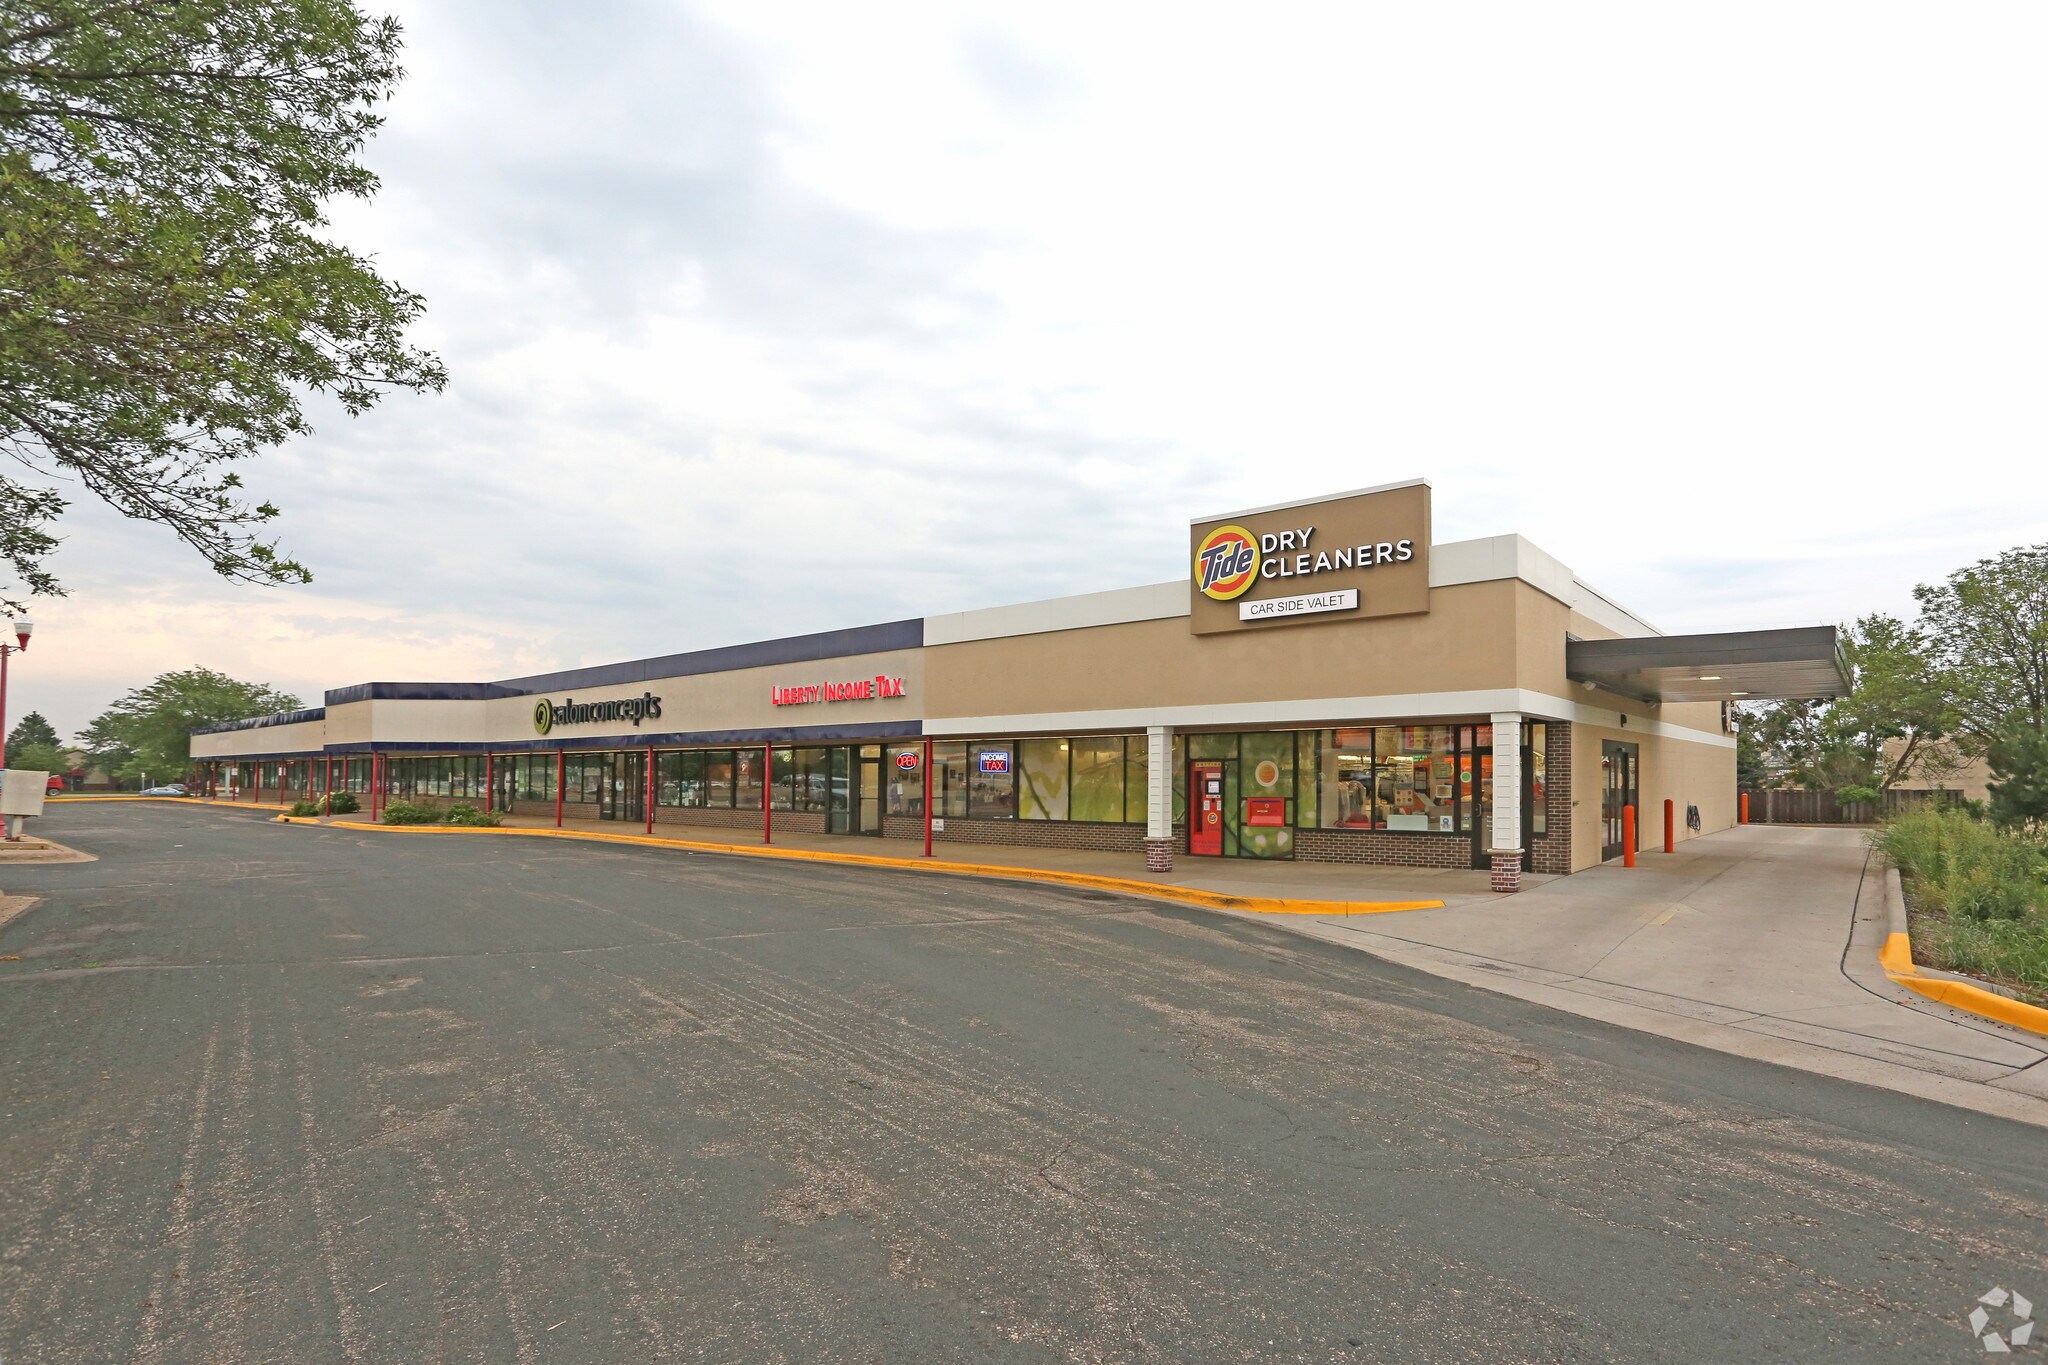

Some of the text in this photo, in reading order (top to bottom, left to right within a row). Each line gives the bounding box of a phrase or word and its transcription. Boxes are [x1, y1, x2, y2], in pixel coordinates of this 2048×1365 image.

[1261, 526, 1315, 554] DRY
[1199, 539, 1255, 592] Tide
[1261, 539, 1414, 579] CLEANERS
[1250, 594, 1345, 615] CAR SIDE VALET
[772, 675, 905, 705] LIBERTY INCOME TAX
[551, 691, 662, 726] salonconcepts
[896, 755, 919, 767] OPEN
[982, 753, 1007, 761] INCOME
[985, 761, 1004, 771] TAX
